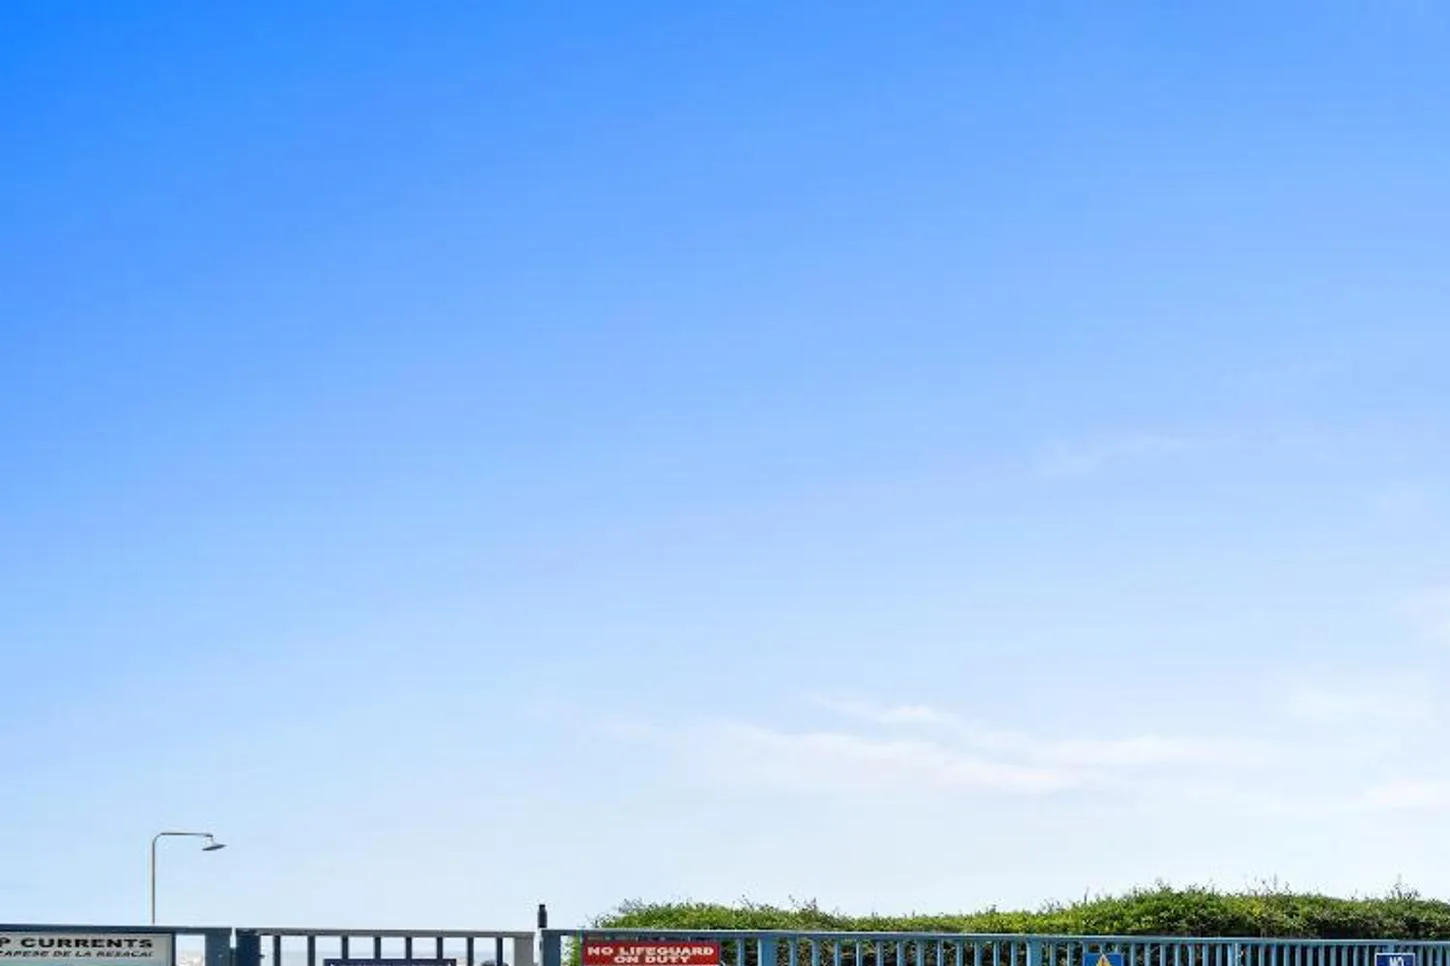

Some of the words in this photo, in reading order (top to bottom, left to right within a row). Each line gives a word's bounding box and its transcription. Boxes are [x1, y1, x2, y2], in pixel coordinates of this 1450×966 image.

[21, 938, 153, 948] CURRENTS
[587, 946, 614, 955] NO
[620, 946, 714, 956] LIFEGUARD
